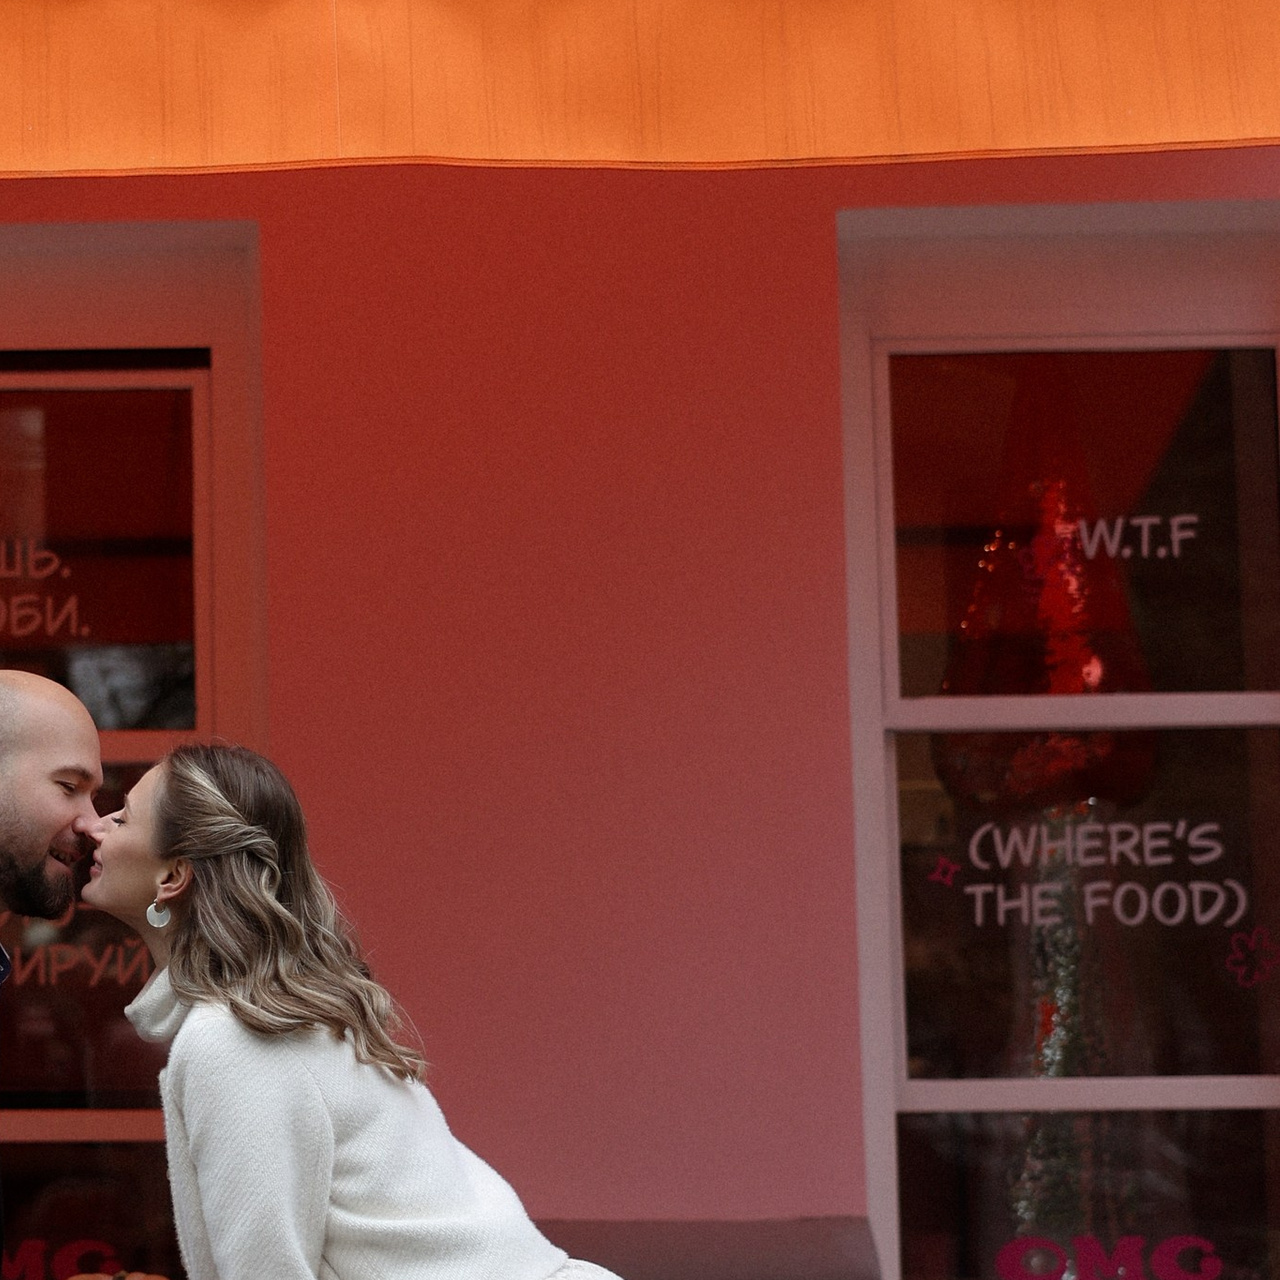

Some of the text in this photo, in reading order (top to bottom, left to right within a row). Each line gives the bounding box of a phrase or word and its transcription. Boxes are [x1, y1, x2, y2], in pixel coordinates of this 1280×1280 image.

[969, 820, 1223, 869] (WHERE'S
[964, 880, 1248, 927] THE FOOD)
[12, 937, 152, 987] ИРУЙ
